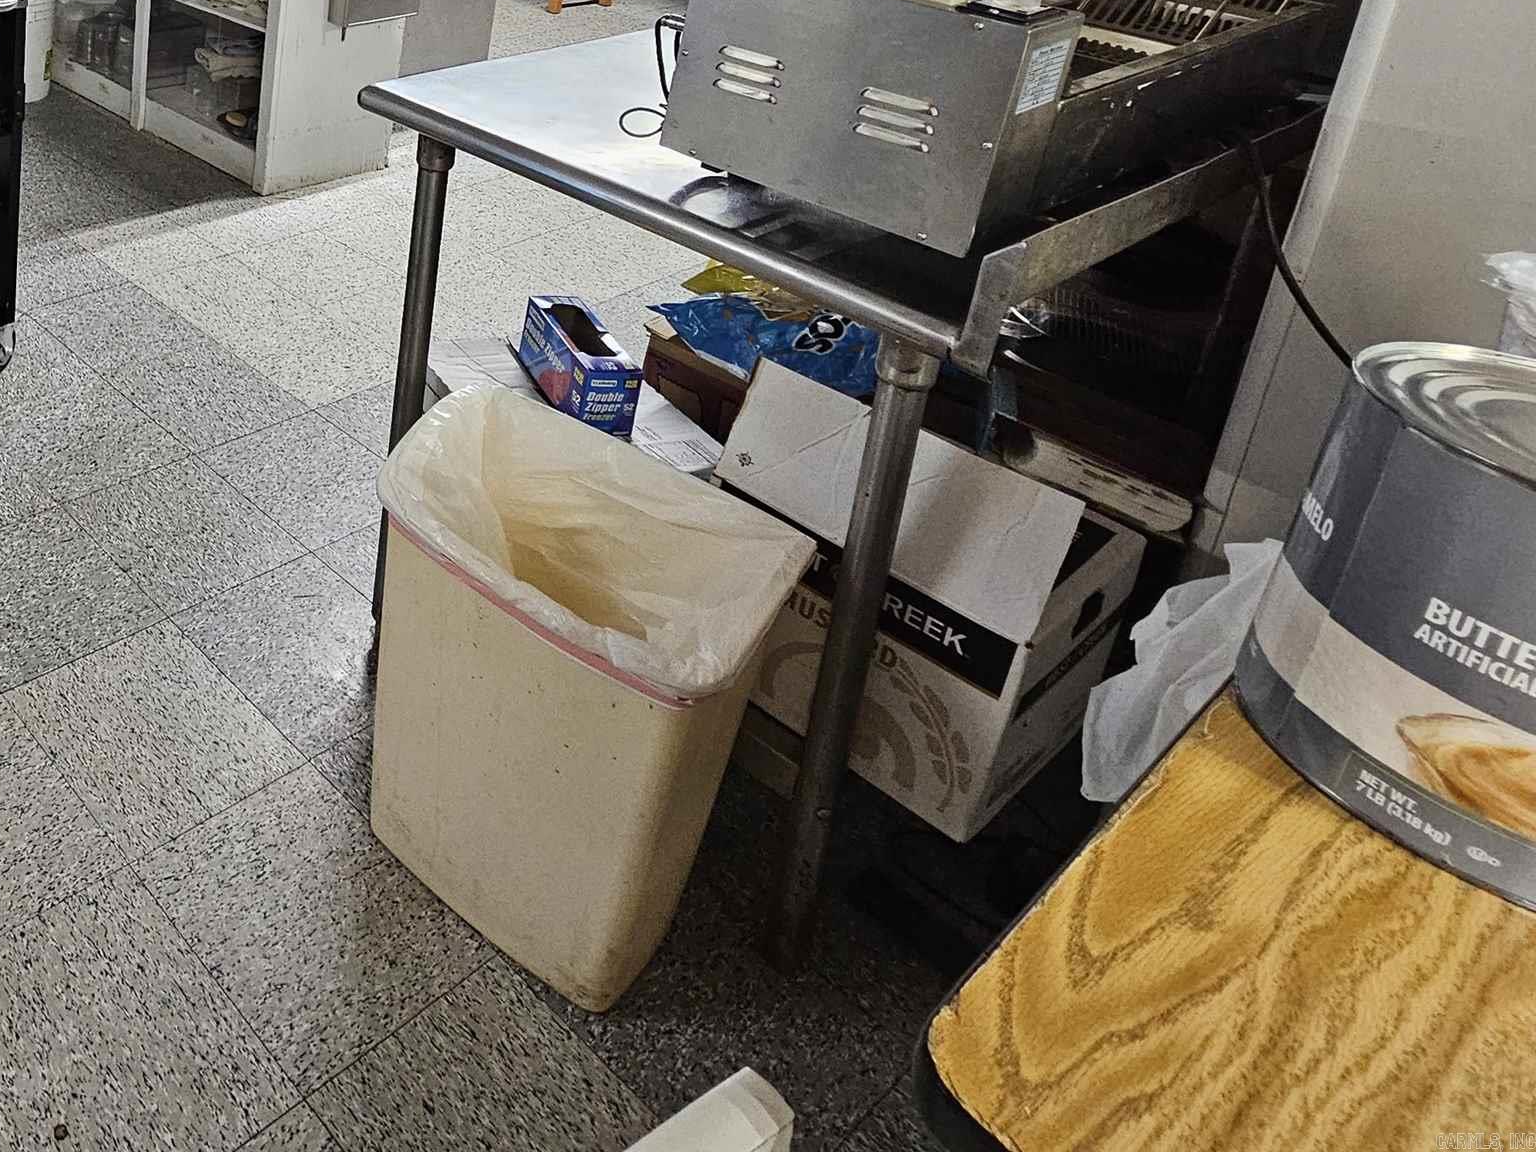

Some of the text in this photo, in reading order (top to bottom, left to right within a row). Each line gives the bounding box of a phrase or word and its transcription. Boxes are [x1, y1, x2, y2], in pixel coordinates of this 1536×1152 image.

[792, 310, 852, 355] SO
[584, 402, 622, 414] Zipper
[586, 391, 624, 402] Double
[1301, 493, 1335, 542] MELO
[882, 591, 968, 657] REEK
[1424, 597, 1536, 671] BUTTE
[1359, 769, 1390, 793] NET
[1355, 779, 1453, 846] 7 LB (3.18 kg)
